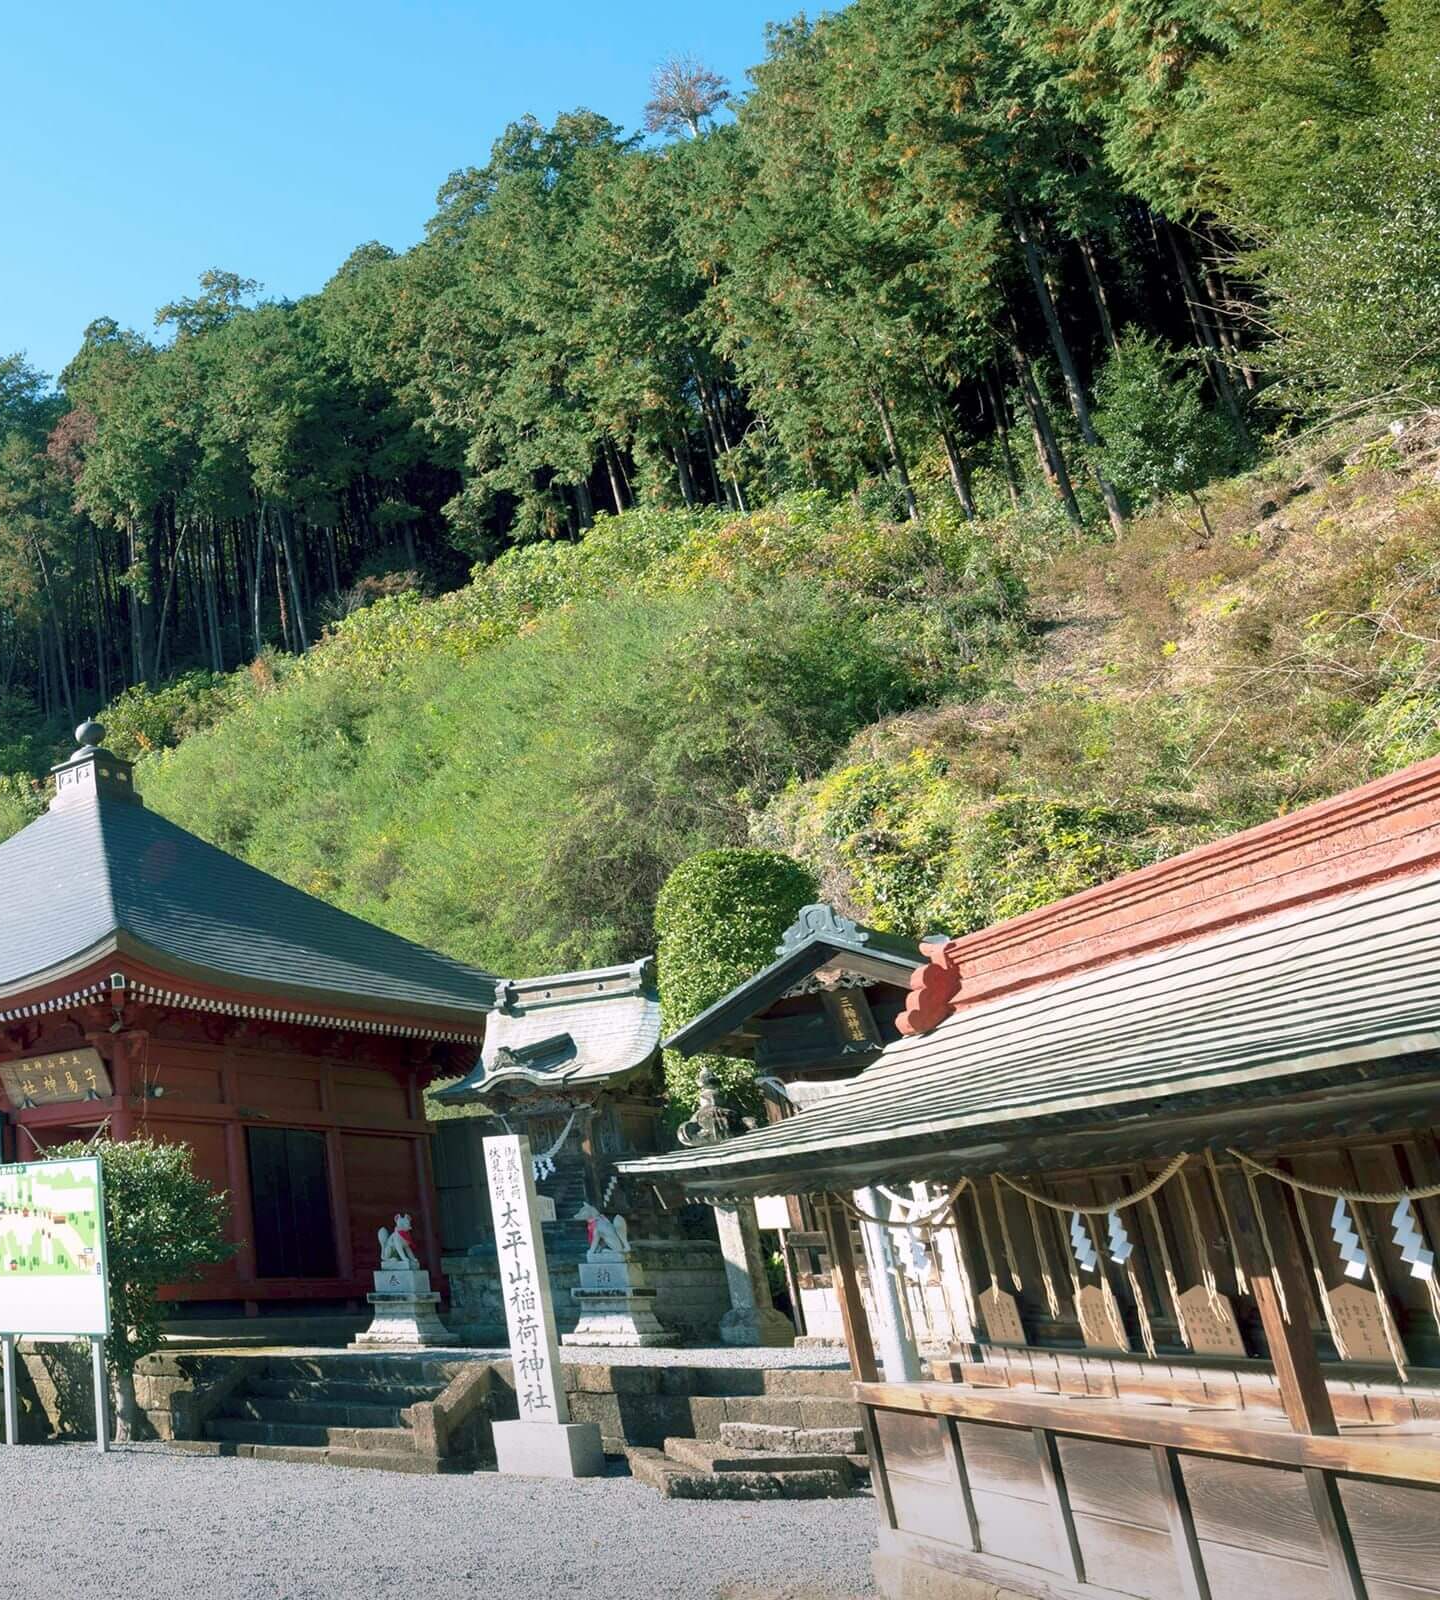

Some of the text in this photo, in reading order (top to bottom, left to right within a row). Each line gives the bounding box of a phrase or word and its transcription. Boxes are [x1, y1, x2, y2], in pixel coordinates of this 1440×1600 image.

[840, 996, 866, 1041] 三輪神社
[21, 1067, 97, 1096] 子易神社
[489, 1146, 505, 1201] 伏見稲荷
[500, 1201, 552, 1413] 太平山稲荷神社
